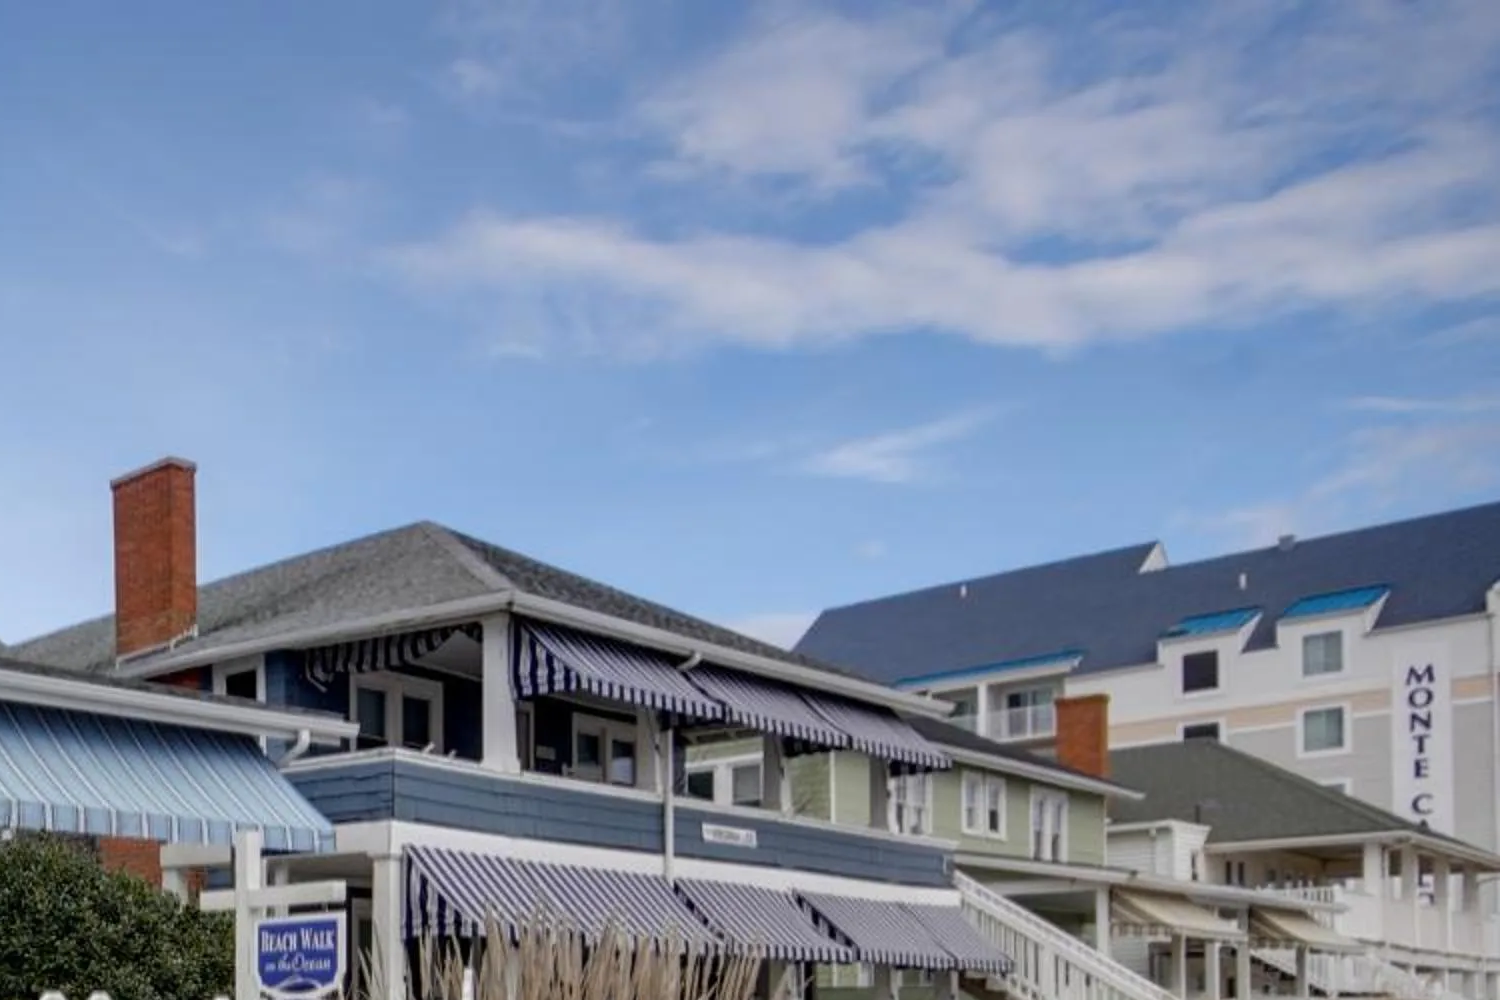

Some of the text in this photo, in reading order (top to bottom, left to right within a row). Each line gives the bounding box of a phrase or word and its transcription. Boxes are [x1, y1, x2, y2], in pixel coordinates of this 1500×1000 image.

[1404, 663, 1436, 779] MONTE
[261, 927, 335, 953] BEACH WALK
[277, 953, 291, 972] the
[291, 951, 331, 973] Ocean
